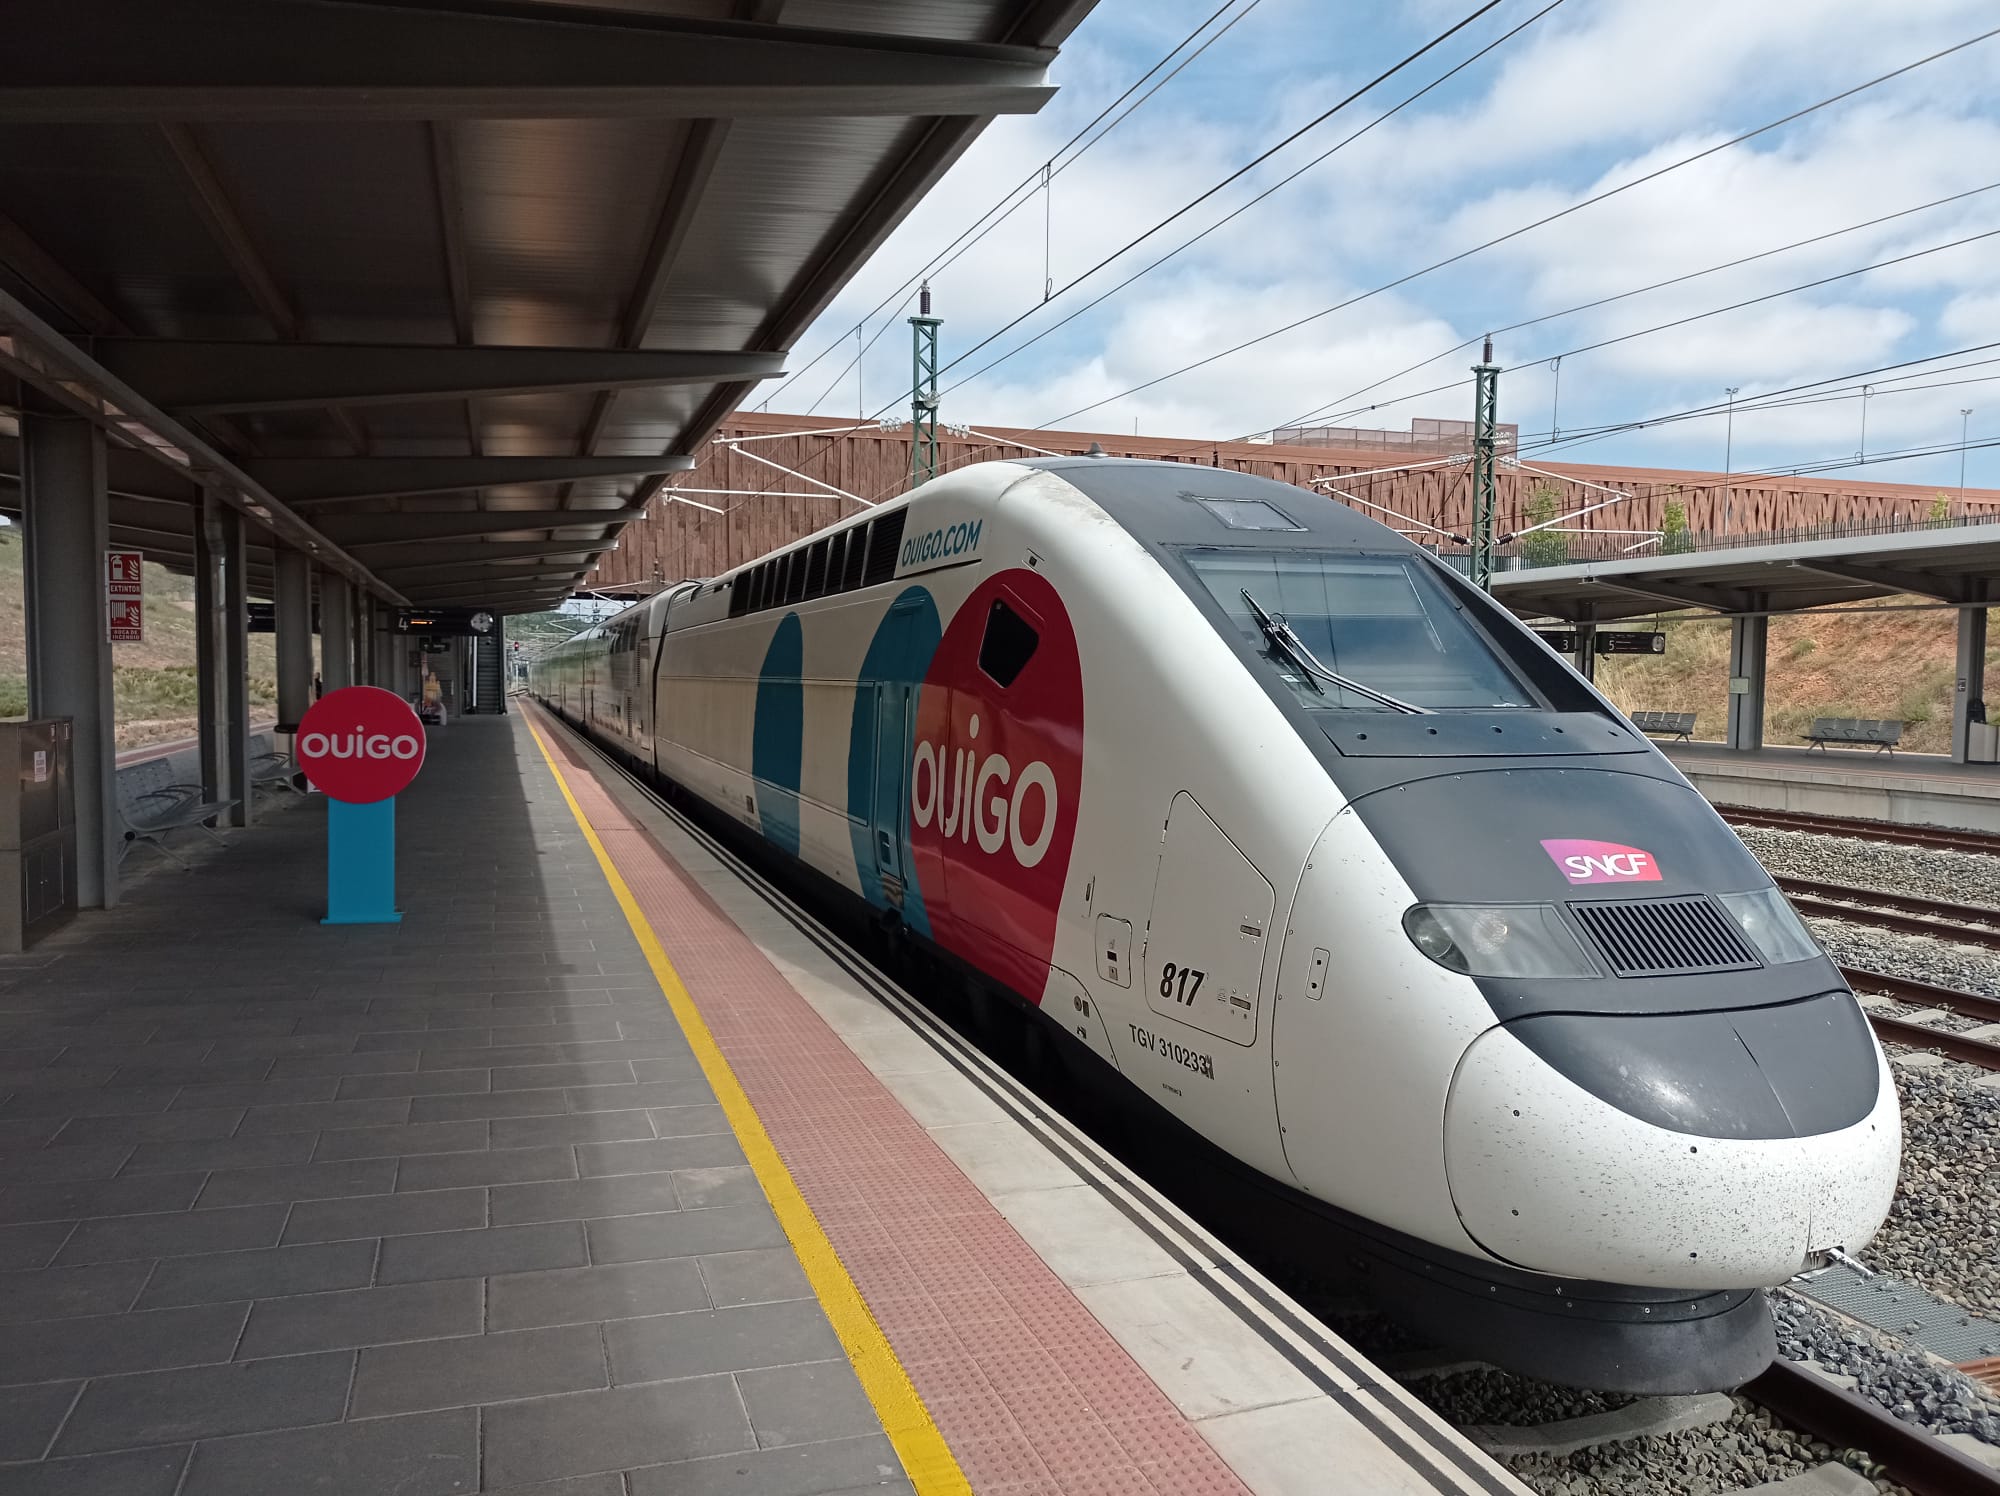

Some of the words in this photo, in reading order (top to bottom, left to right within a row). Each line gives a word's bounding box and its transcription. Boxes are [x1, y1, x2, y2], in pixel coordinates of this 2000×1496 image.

[902, 519, 982, 567] OUIGO.COM
[110, 585, 140, 593] EXTINTOR
[399, 617, 408, 631] 4
[1563, 639, 1569, 650] 3
[1609, 640, 1615, 651] 5
[1564, 853, 1648, 878] SNCF
[1159, 962, 1205, 1007] 817
[1128, 1023, 1156, 1051] TGV
